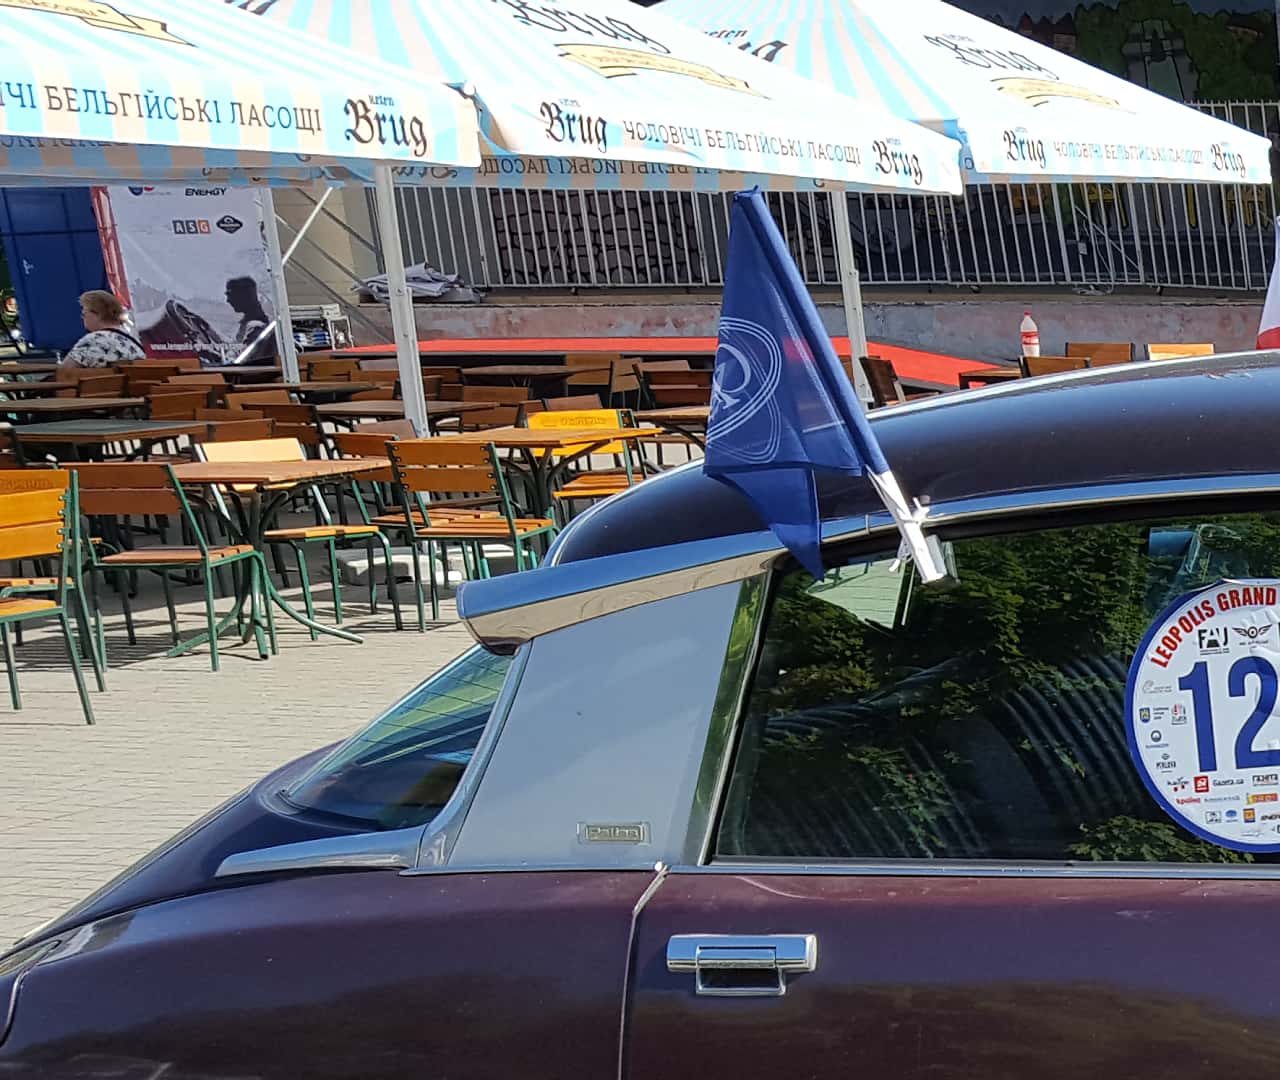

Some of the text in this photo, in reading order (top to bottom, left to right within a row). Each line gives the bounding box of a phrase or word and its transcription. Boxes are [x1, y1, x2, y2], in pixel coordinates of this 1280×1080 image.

[44, 85, 222, 123] БЕЛЬГІЙСЬКІ
[230, 101, 323, 135] ЛАСОЩІ
[344, 98, 427, 157] Brug
[540, 101, 607, 154] Brug
[623, 120, 861, 167] ЧОЛОВІЧІ БЕЛЬГІЙСЬКІ ЛАСОЩІ
[872, 140, 923, 185] Brug
[1002, 129, 1047, 169] Brug
[1210, 143, 1246, 178] Brug
[185, 188, 226, 196] ENERGY
[173, 220, 211, 234] ASG
[1151, 600, 1215, 667] LEOPOLIS
[1217, 587, 1277, 611] GRAND
